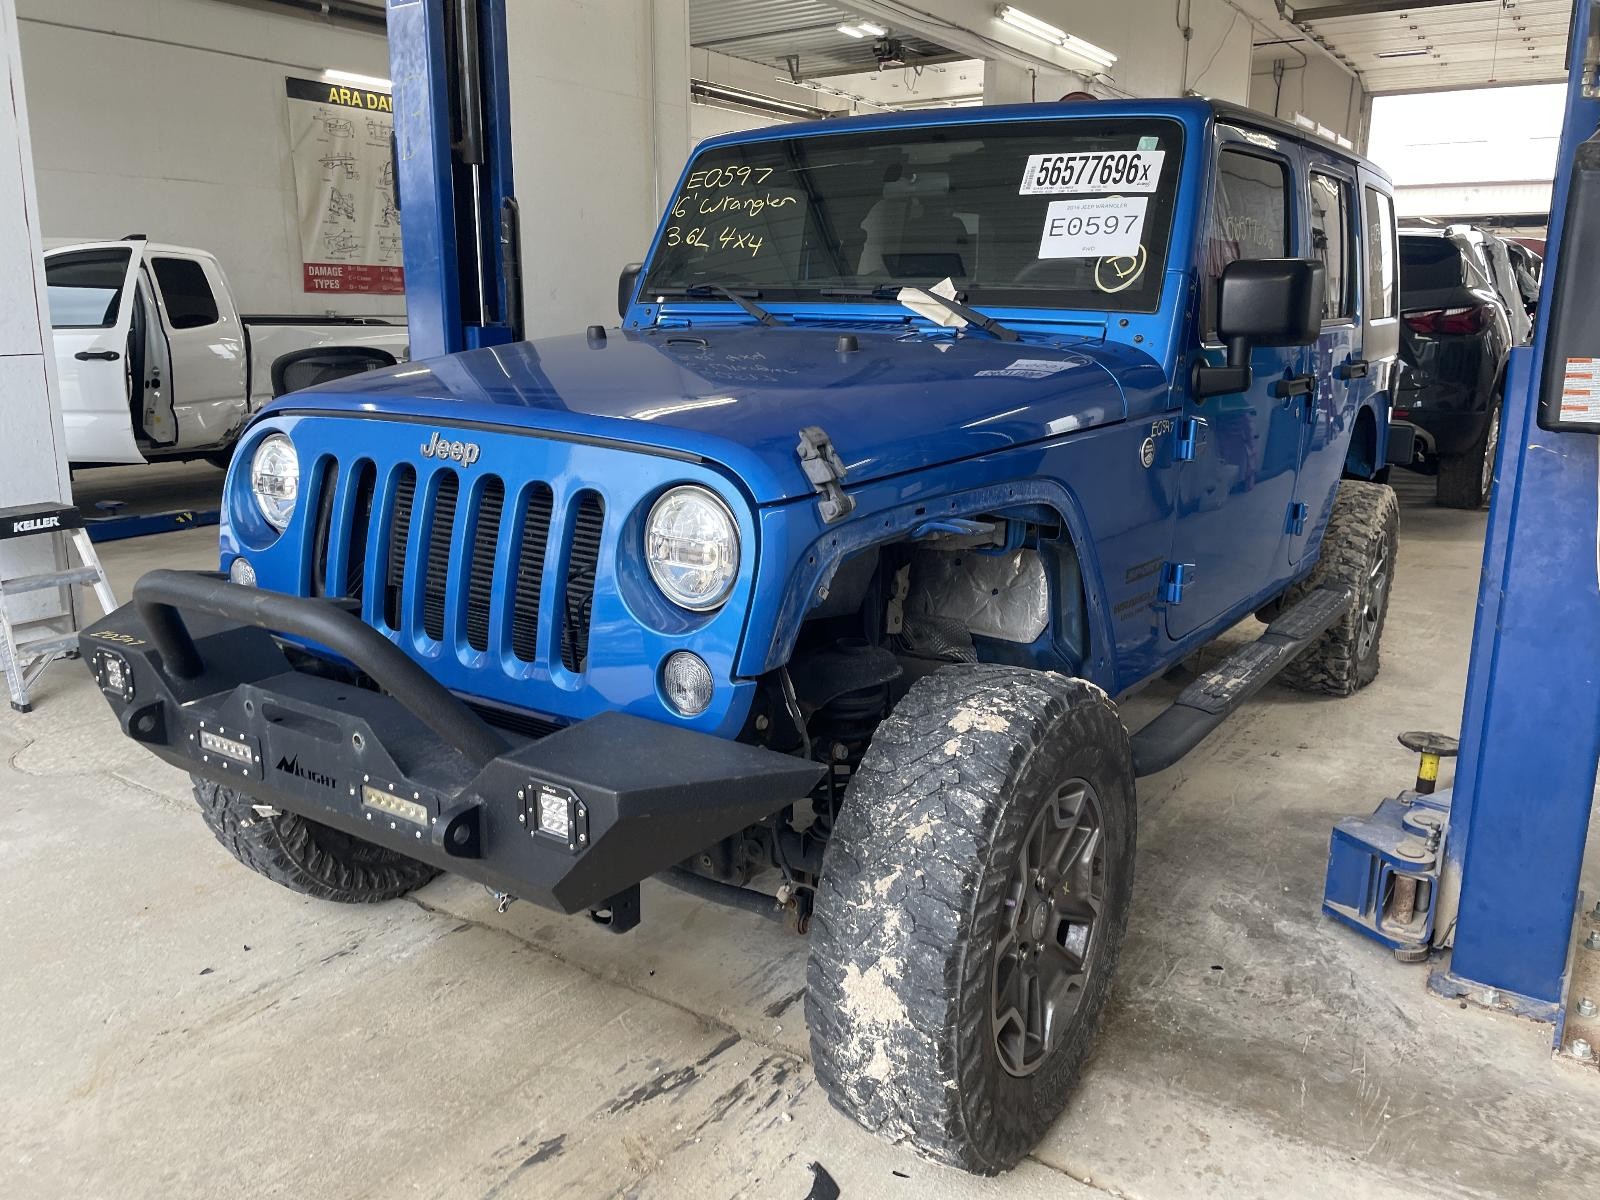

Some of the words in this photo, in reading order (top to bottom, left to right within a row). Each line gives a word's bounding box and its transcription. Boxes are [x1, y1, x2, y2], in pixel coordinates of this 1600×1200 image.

[329, 87, 363, 107] ARA
[687, 166, 773, 189] E0597
[1036, 153, 1142, 186] 56577696
[1049, 215, 1139, 237] E0597
[308, 266, 343, 277] DAMAGE
[313, 279, 340, 289] TYPES
[420, 431, 481, 468] Jeep
[13, 516, 61, 533] KELLER
